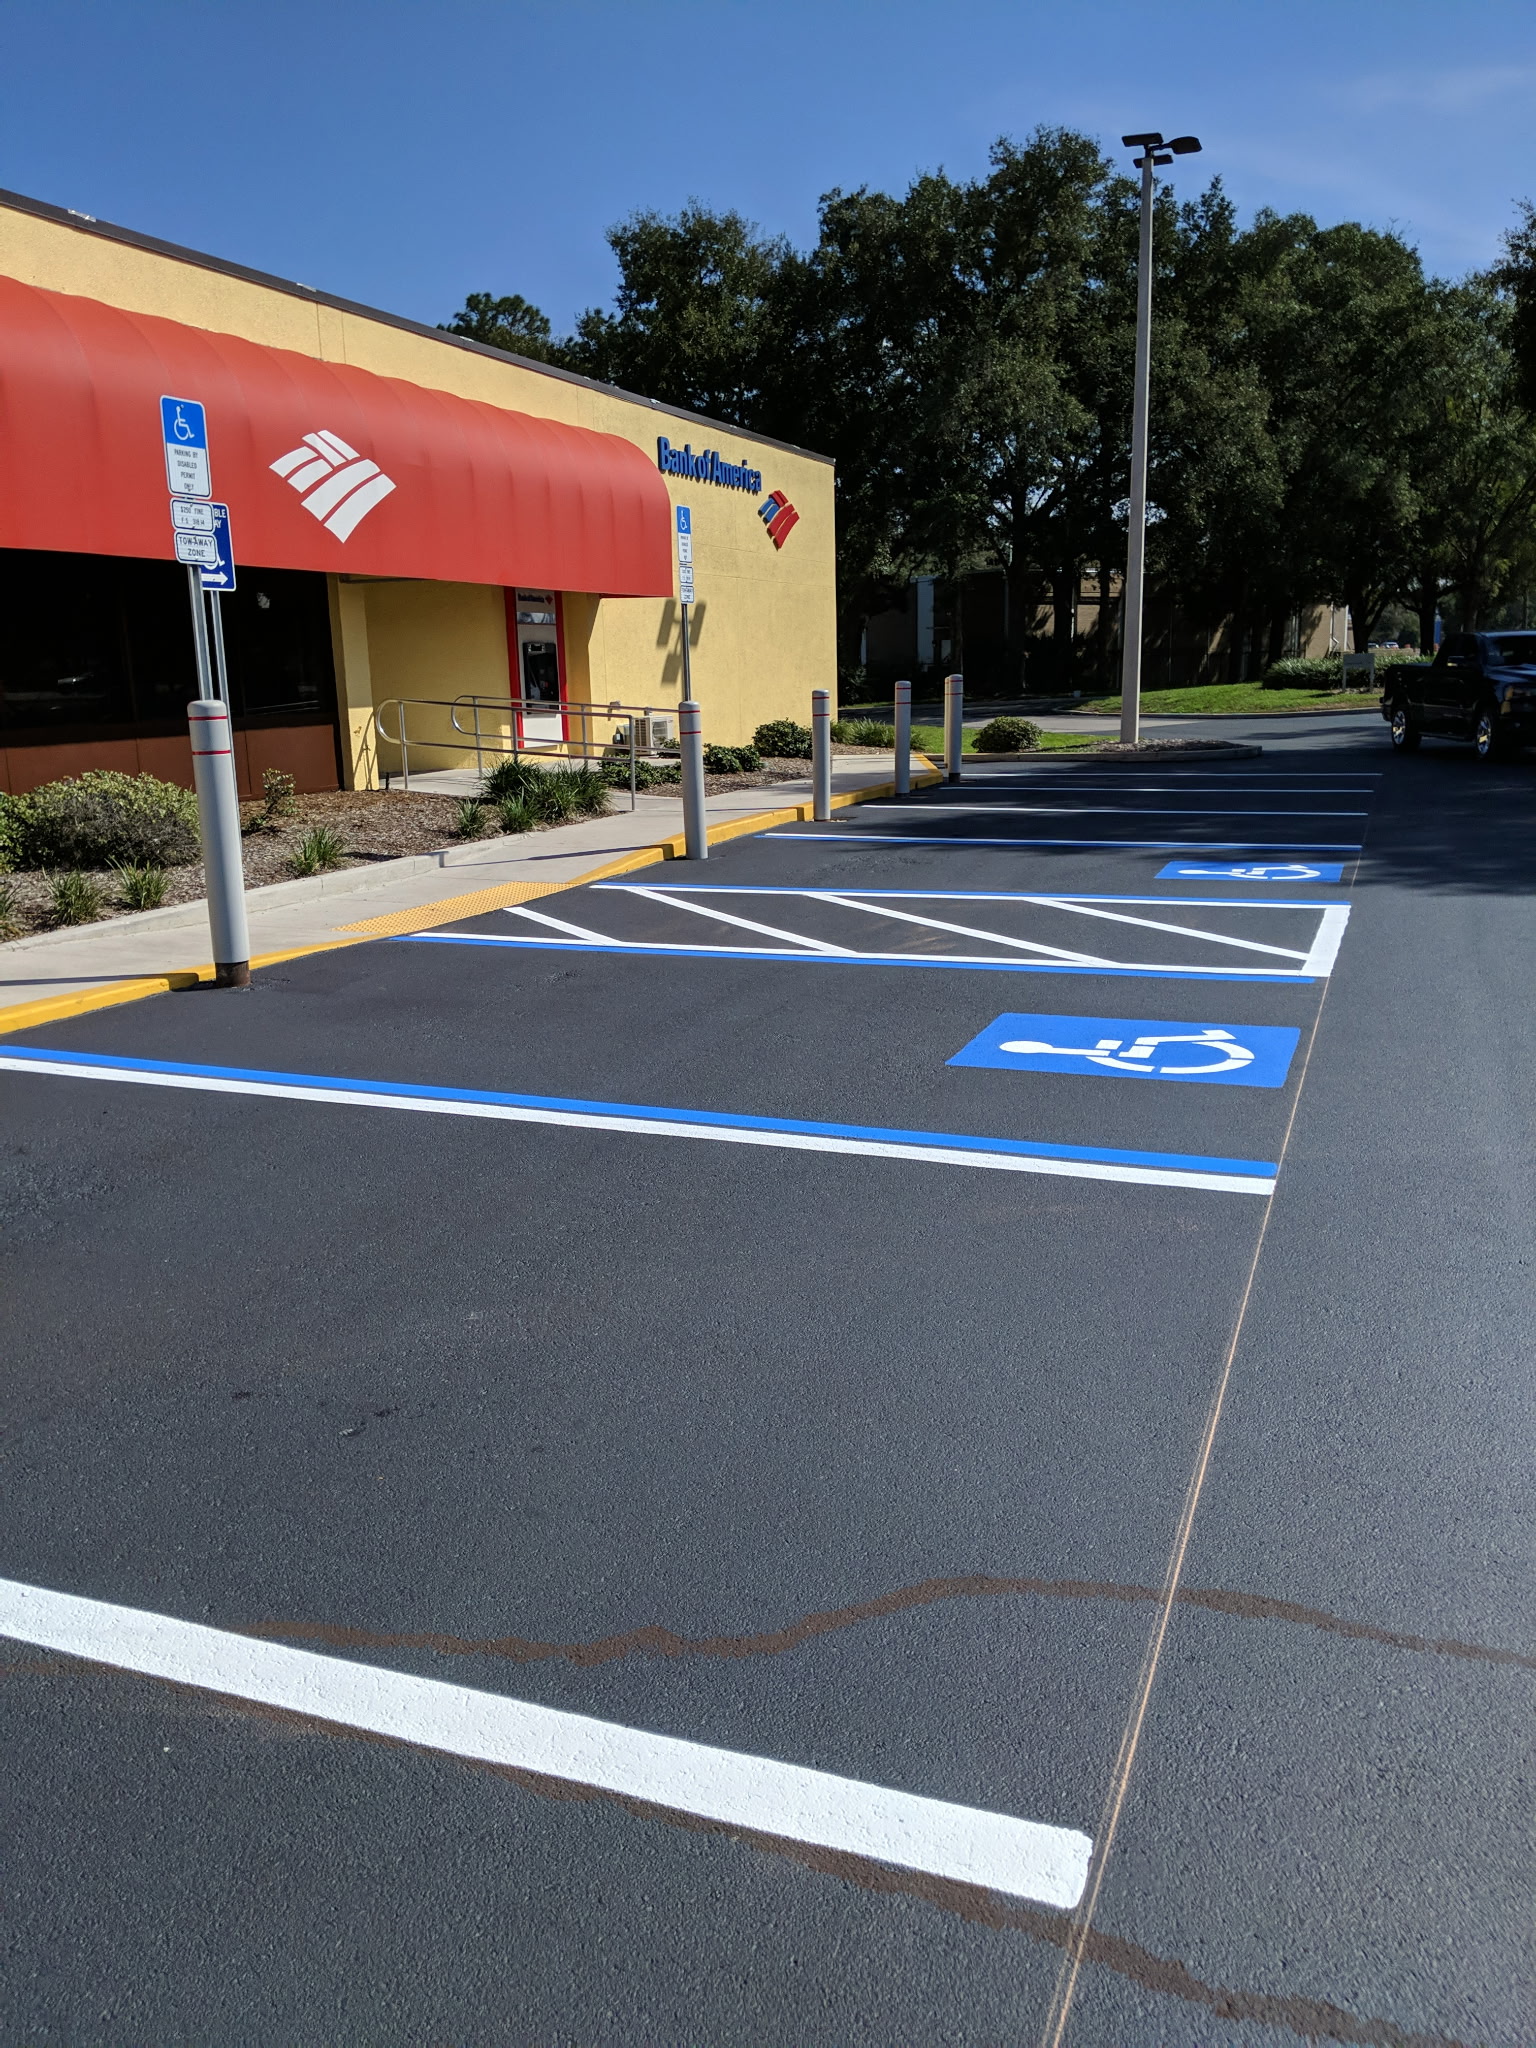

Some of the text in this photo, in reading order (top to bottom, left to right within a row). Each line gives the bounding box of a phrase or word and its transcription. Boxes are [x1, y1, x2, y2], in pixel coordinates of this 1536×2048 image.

[177, 460, 198, 470] DISABLED
[657, 436, 762, 492] Bank of America
[180, 471, 196, 480] PERMIT
[184, 482, 194, 490] ONLY
[187, 548, 206, 557] ZONE
